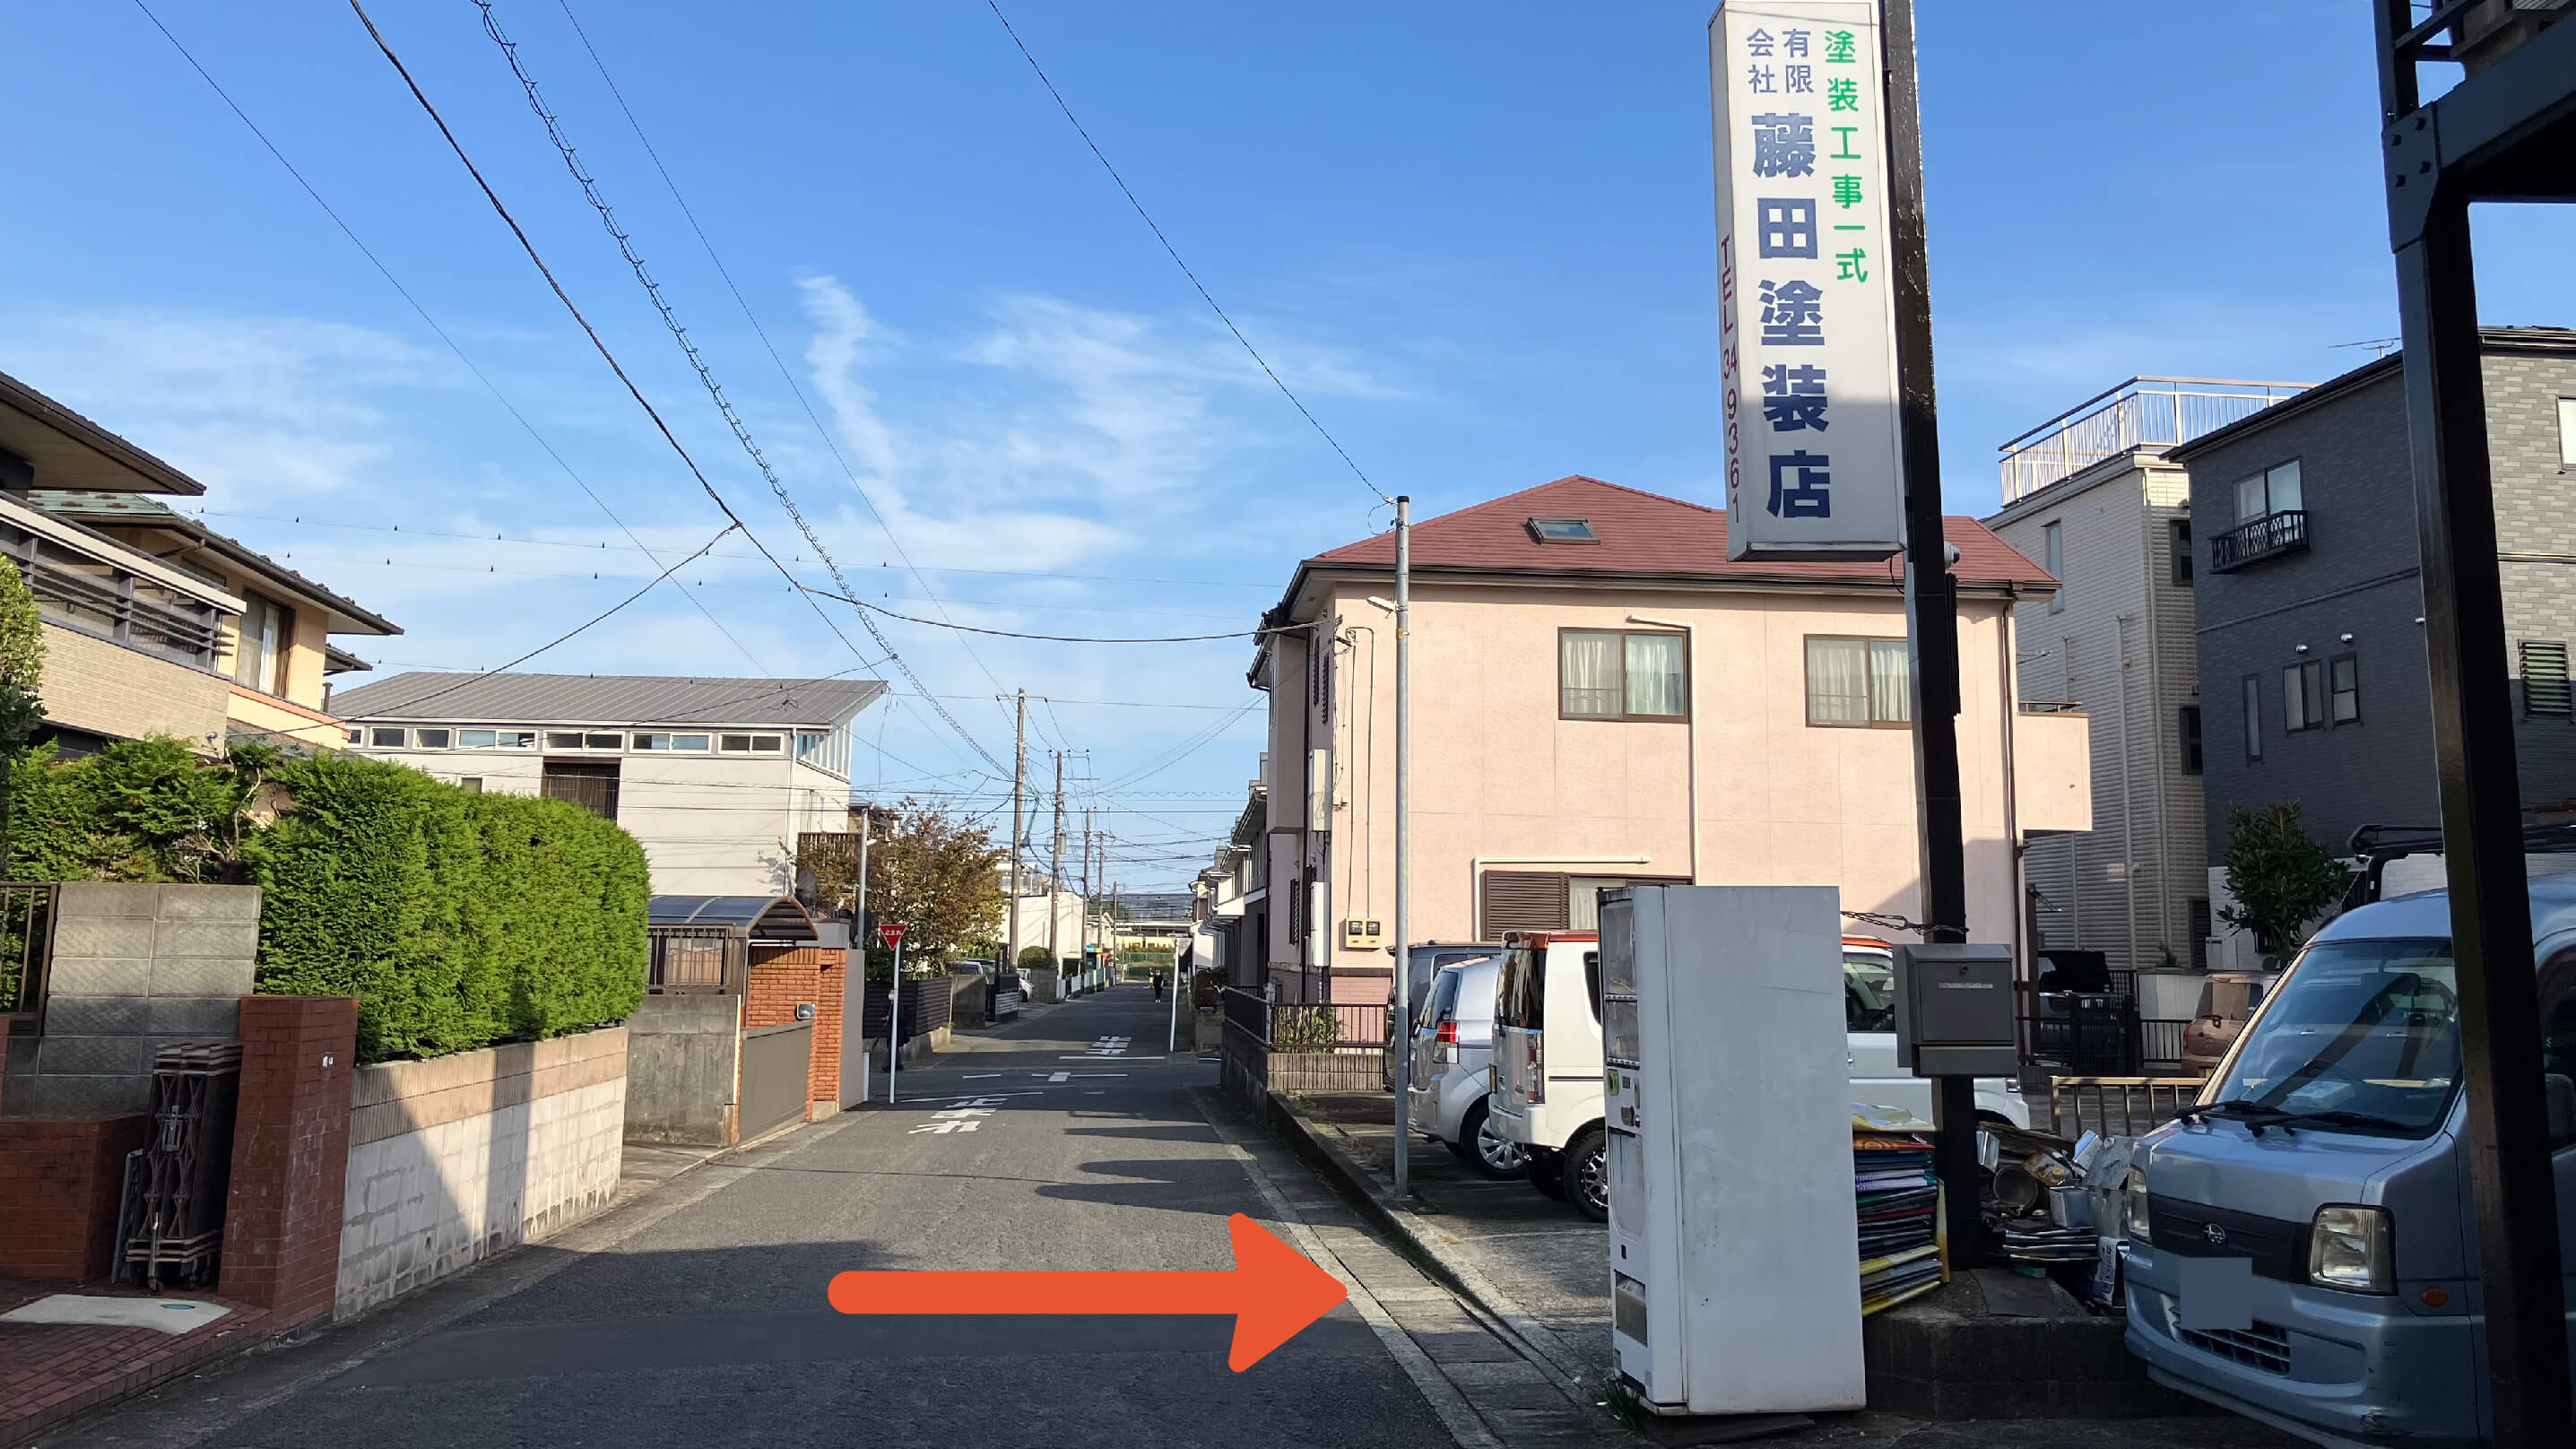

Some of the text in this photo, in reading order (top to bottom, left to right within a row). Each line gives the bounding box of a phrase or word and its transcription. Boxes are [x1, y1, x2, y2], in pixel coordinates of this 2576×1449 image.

[1825, 30, 1868, 283] 塗装工事一式
[1721, 234, 1733, 334] TEL
[1751, 112, 1831, 519] 藤田塗装店
